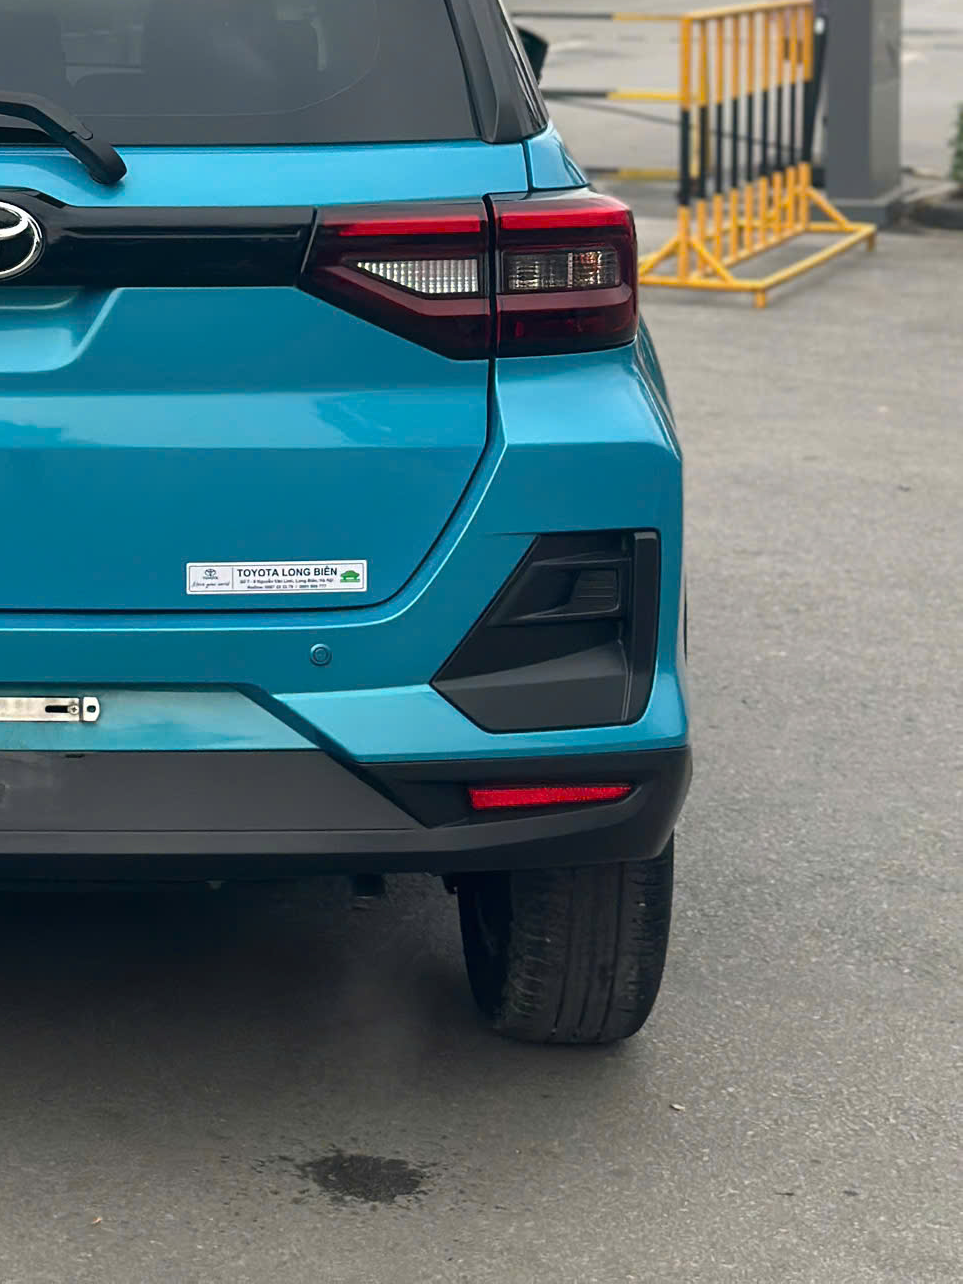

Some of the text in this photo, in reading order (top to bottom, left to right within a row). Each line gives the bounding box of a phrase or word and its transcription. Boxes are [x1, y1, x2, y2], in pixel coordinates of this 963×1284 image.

[237, 565, 338, 577] TOYOTA LONG BIÊN
